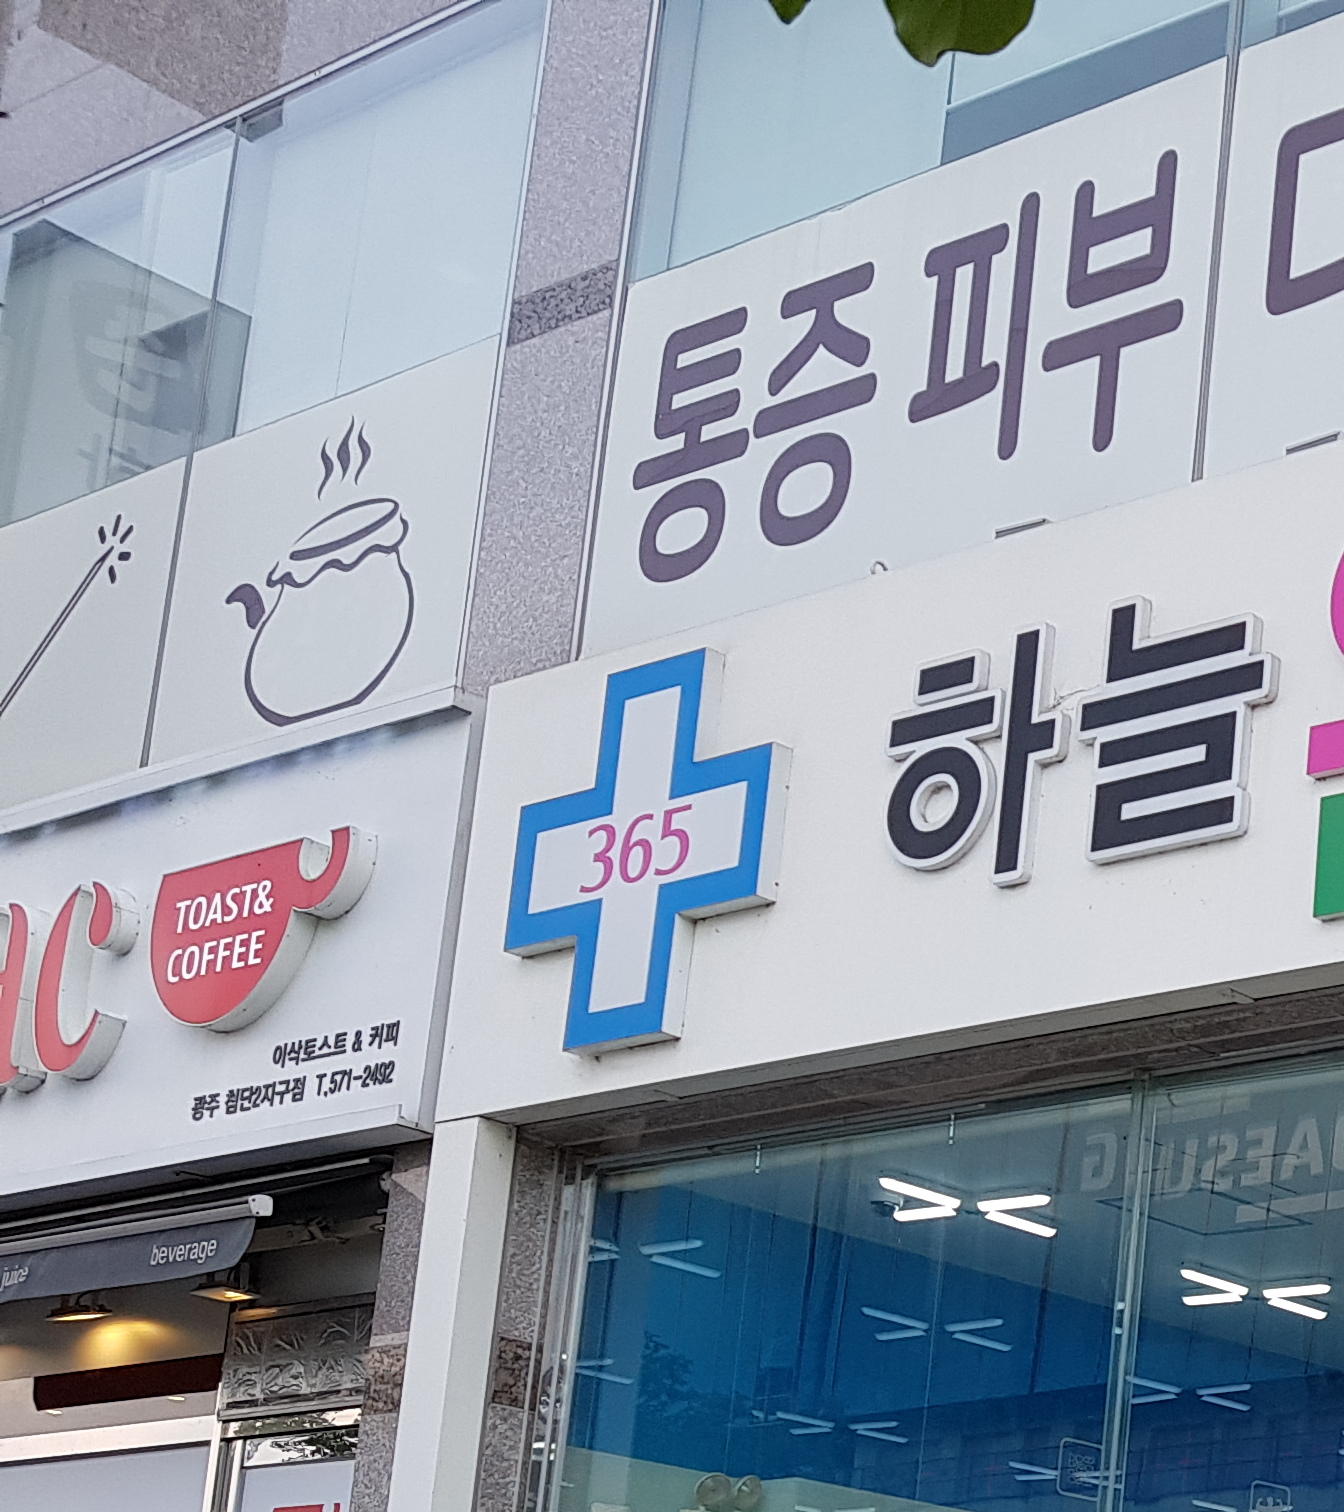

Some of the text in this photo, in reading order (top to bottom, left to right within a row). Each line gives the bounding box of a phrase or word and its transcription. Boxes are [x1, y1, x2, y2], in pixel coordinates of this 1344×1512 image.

[633, 260, 878, 583] 통증
[908, 149, 1184, 461] 피부
[579, 803, 695, 895] 365
[166, 929, 266, 984] COFFEE
[272, 1019, 401, 1068] 이삭토스트 & 커피
[191, 1092, 221, 1121] 광주
[225, 1075, 307, 1115] 첨단2지구점
[150, 1239, 217, 1266] beverage
[0, 1264, 29, 1292] juice
